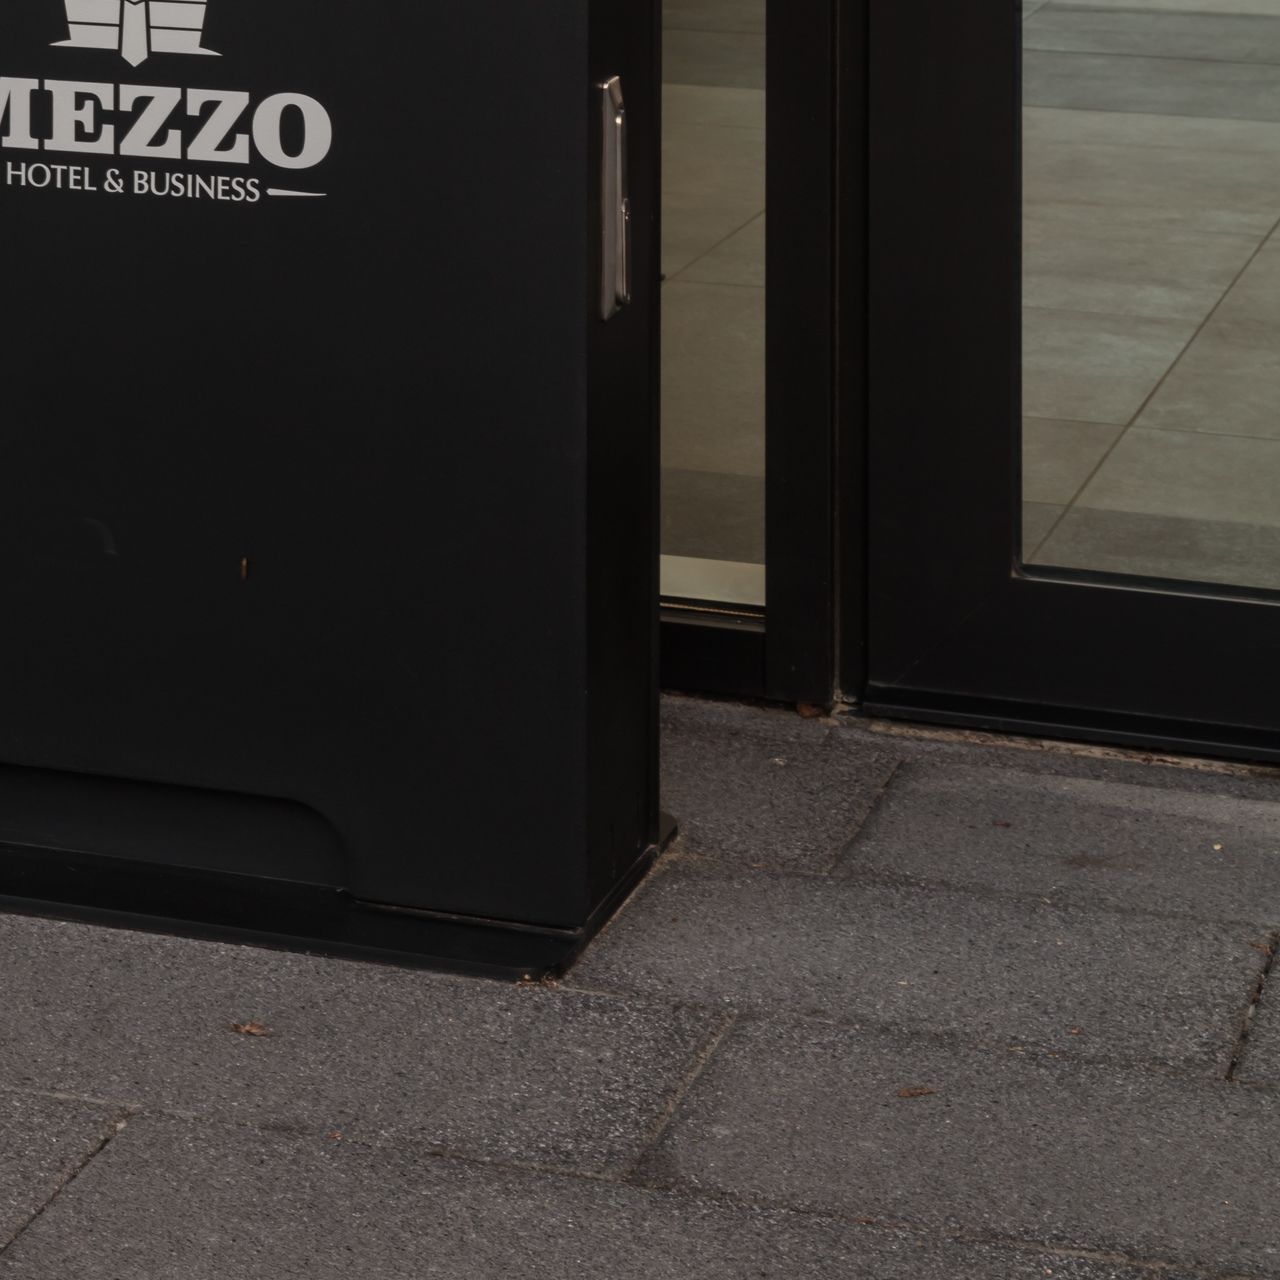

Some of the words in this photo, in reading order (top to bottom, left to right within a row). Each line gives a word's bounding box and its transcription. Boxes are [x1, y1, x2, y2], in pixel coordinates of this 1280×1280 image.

[6, 161, 97, 191] HOTEL
[103, 168, 124, 194] &
[133, 170, 260, 203] BUSINESS
